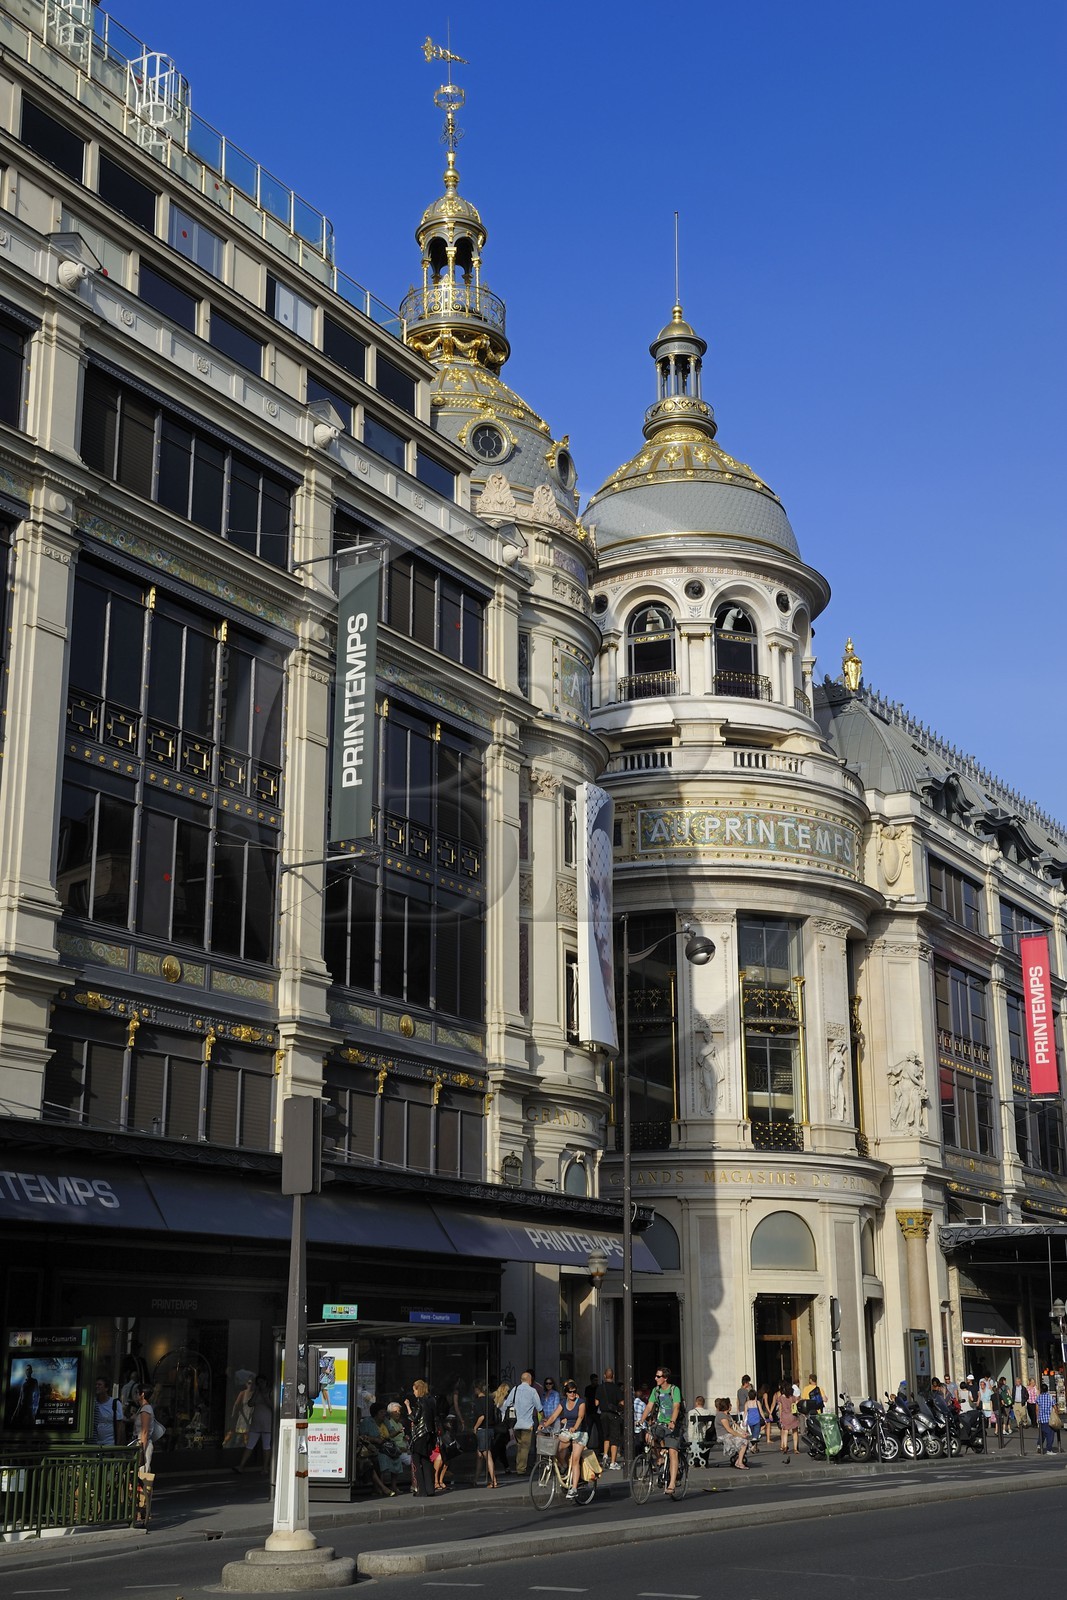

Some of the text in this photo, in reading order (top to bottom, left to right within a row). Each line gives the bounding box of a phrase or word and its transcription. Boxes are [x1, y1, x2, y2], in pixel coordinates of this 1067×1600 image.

[342, 612, 368, 788] PRINTEMPS
[650, 816, 852, 861] AU PRINTEMPS
[1028, 965, 1051, 1064] PRINTEMPS
[525, 1105, 587, 1129] GRANDS
[0, 1170, 120, 1209] TEMPS
[609, 1170, 684, 1185] GANDS
[703, 1169, 797, 1187] MAGASINS
[812, 1173, 831, 1187] DU
[523, 1227, 624, 1257] PRINTEMPS
[151, 1298, 198, 1310] PRINTEMPS
[307, 1433, 340, 1442] en-Aimés
